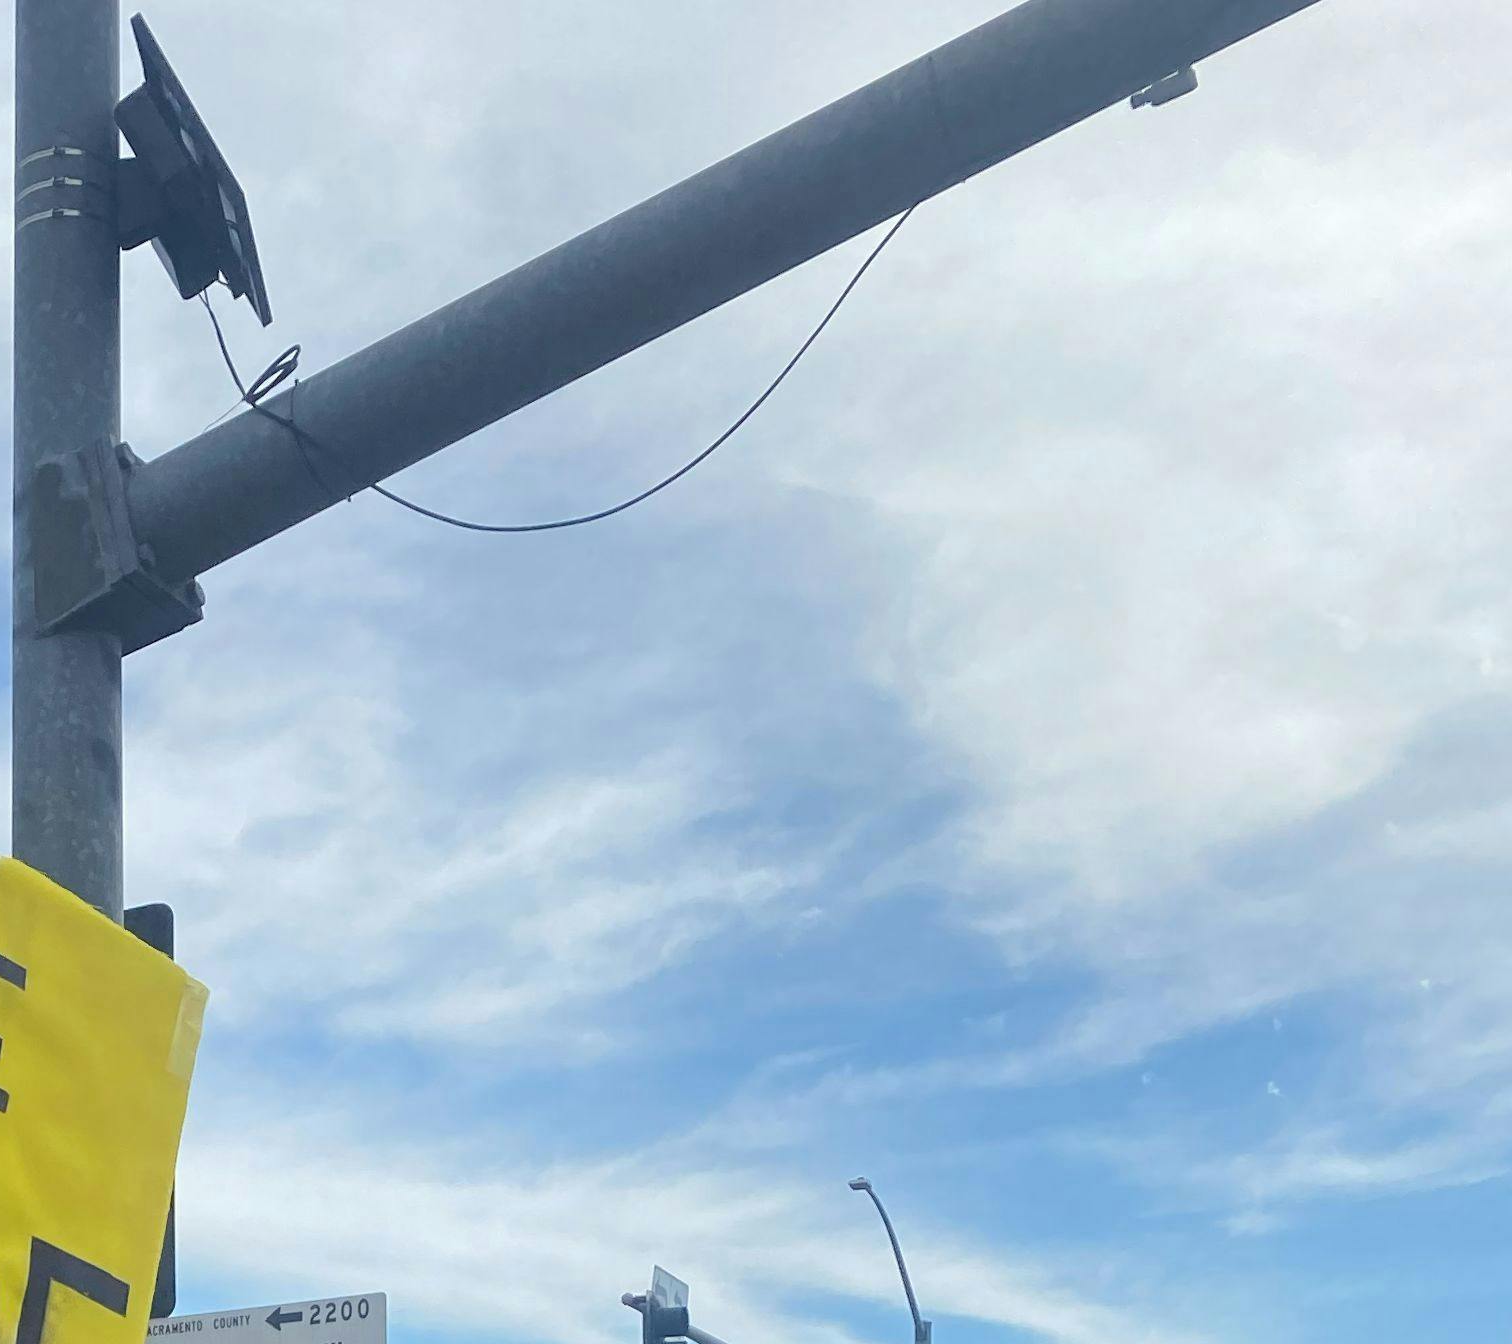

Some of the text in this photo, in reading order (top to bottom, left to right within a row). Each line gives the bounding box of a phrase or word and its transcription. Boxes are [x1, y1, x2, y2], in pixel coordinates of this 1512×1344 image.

[147, 1298, 369, 1336] ACRAMENTO COUNTY 2200
